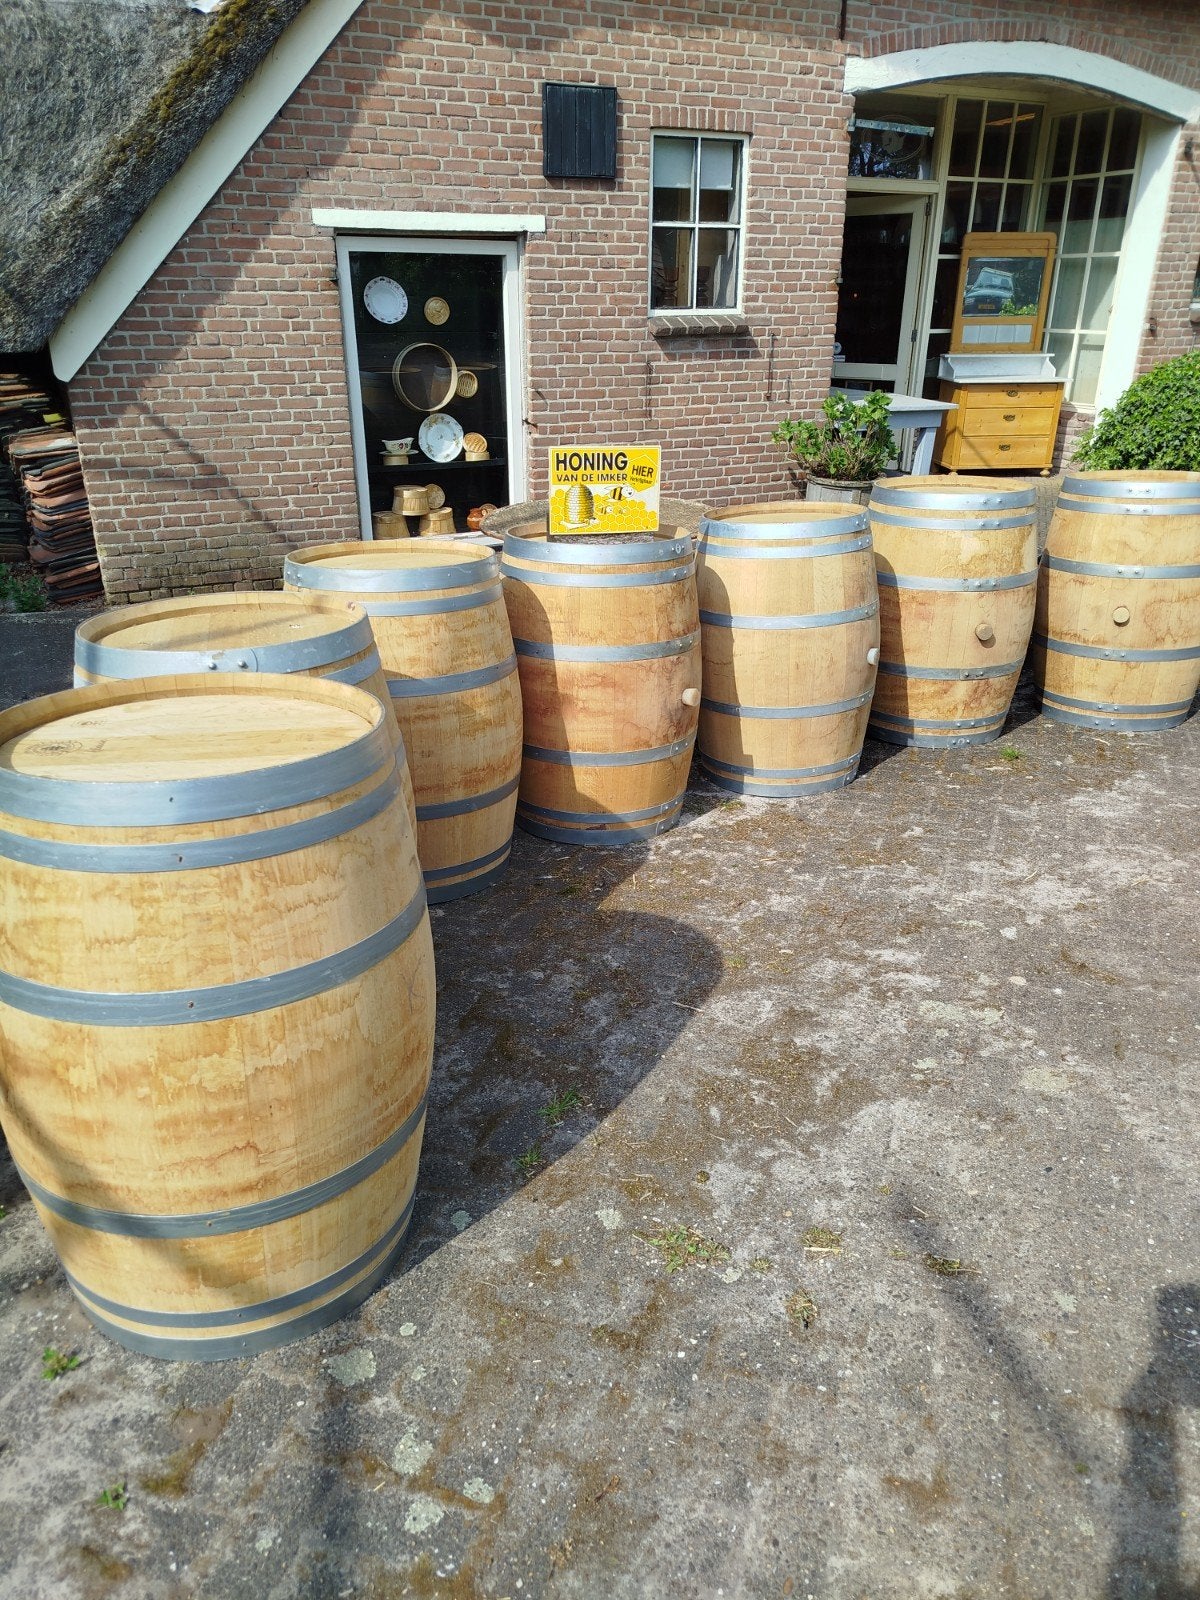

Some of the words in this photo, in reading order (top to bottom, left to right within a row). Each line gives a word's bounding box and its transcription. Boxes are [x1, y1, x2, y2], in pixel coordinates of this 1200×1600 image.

[555, 452, 628, 471] HONING
[556, 474, 578, 482] VAN
[581, 474, 594, 482] DE
[597, 473, 628, 482] IMKER
[631, 464, 654, 478] HIER
